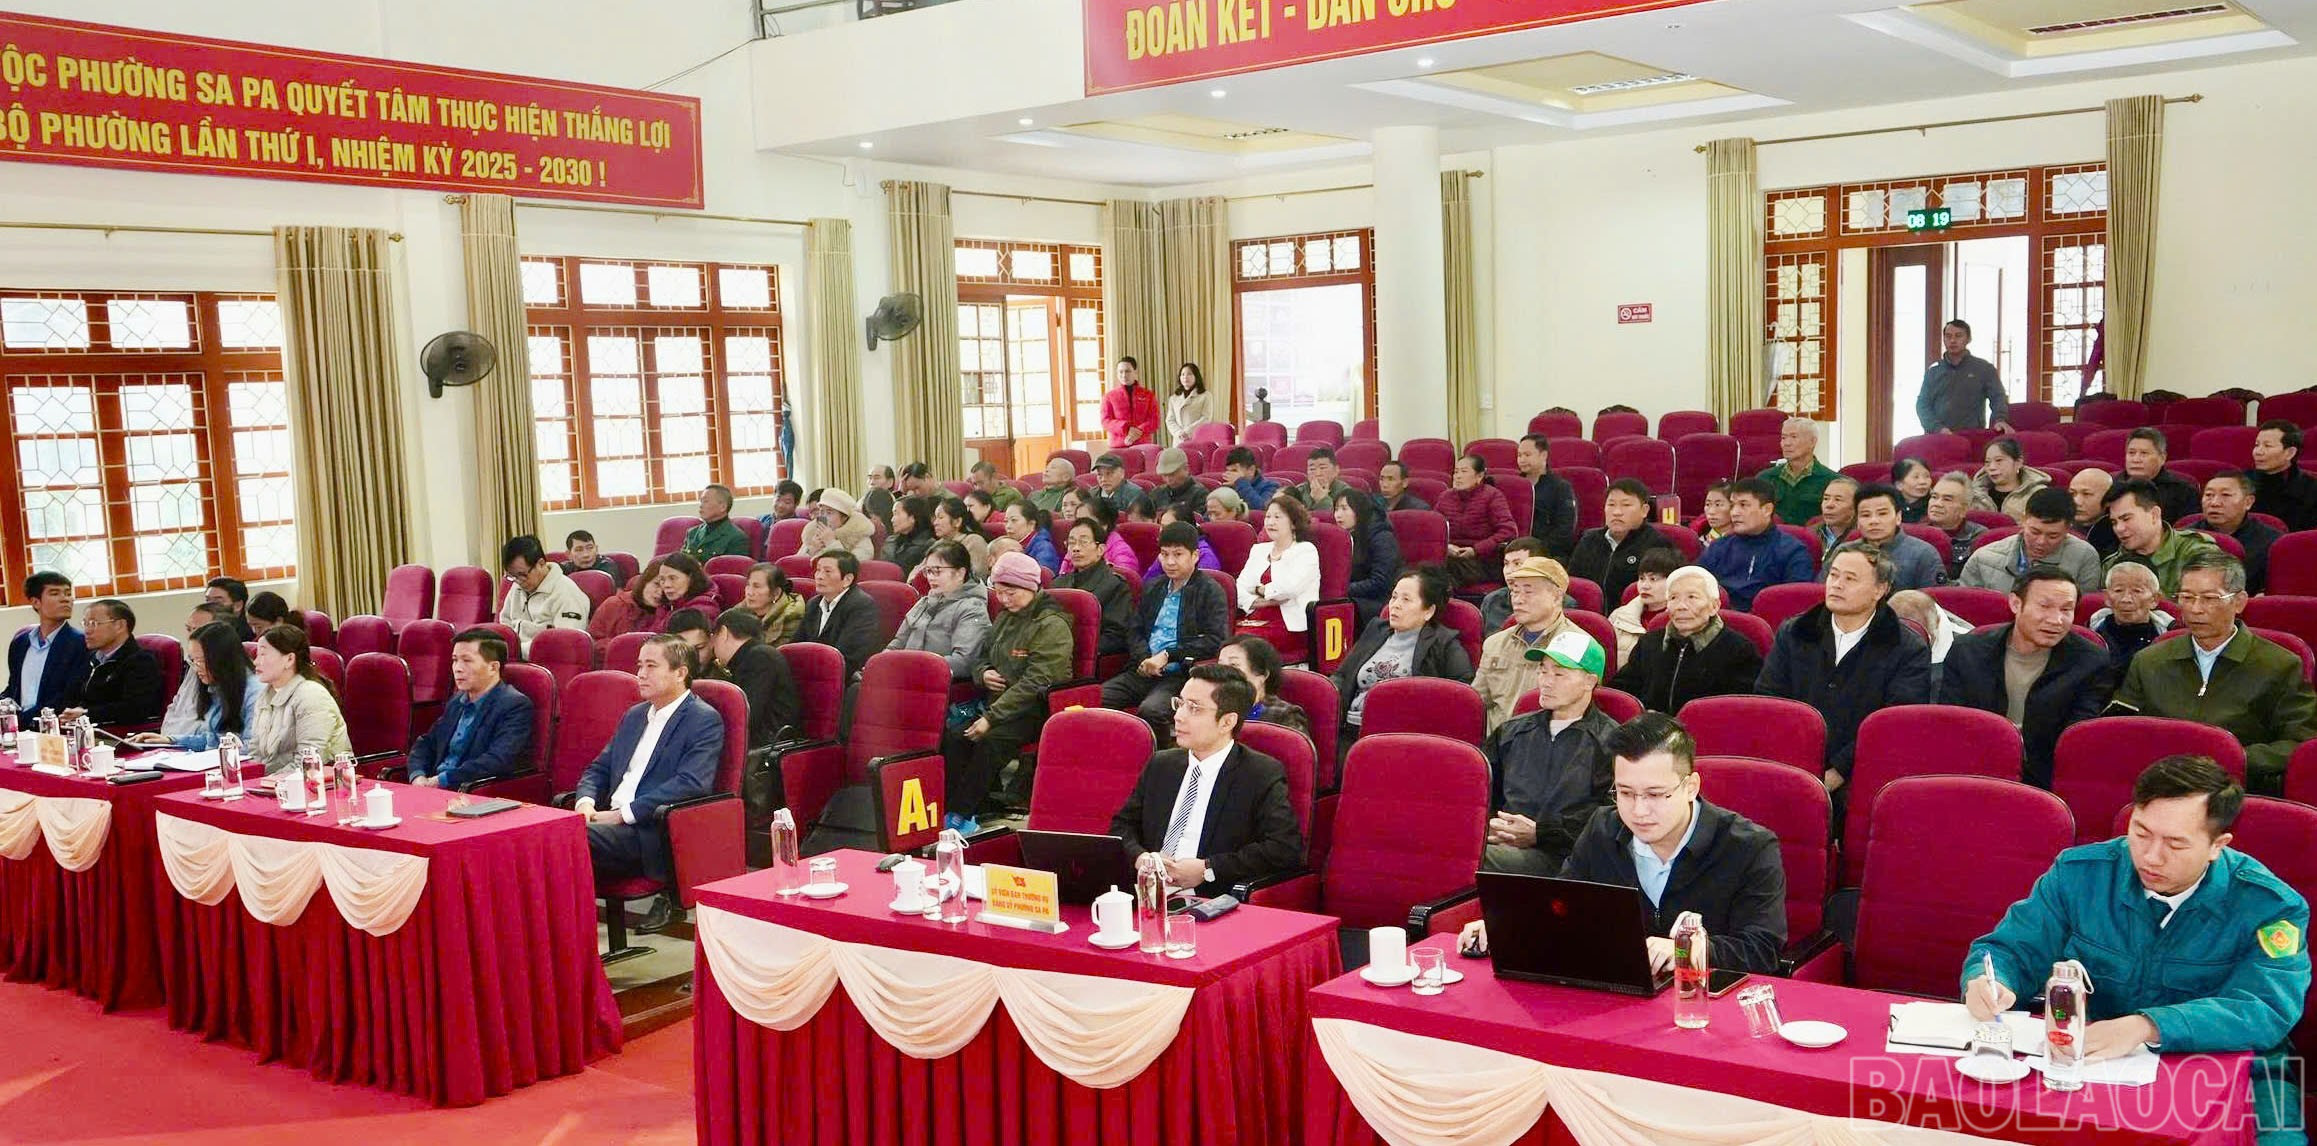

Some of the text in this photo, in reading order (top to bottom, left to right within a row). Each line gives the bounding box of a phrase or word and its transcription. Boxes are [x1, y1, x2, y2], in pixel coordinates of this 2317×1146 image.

[57, 56, 187, 101] PHƯỜNG
[196, 71, 234, 106] SA
[242, 76, 279, 110] PA
[287, 80, 368, 119] QUYẾT
[375, 87, 430, 125] TÂM
[436, 98, 498, 136] THỰC
[505, 103, 557, 141] HIỆN
[563, 105, 633, 146] THẮNG
[639, 119, 671, 154] LỢI
[40, 110, 171, 155] PHƯỜNG
[179, 116, 238, 159] LẦN
[245, 127, 299, 164] THỨ
[306, 135, 324, 169] I,
[332, 136, 416, 177] NHIỆM
[423, 141, 453, 175] KỲ
[461, 150, 517, 180] 2025
[524, 166, 533, 174] -
[539, 155, 592, 186] 2030
[1325, 617, 1343, 661] D
[897, 778, 938, 836] A1
